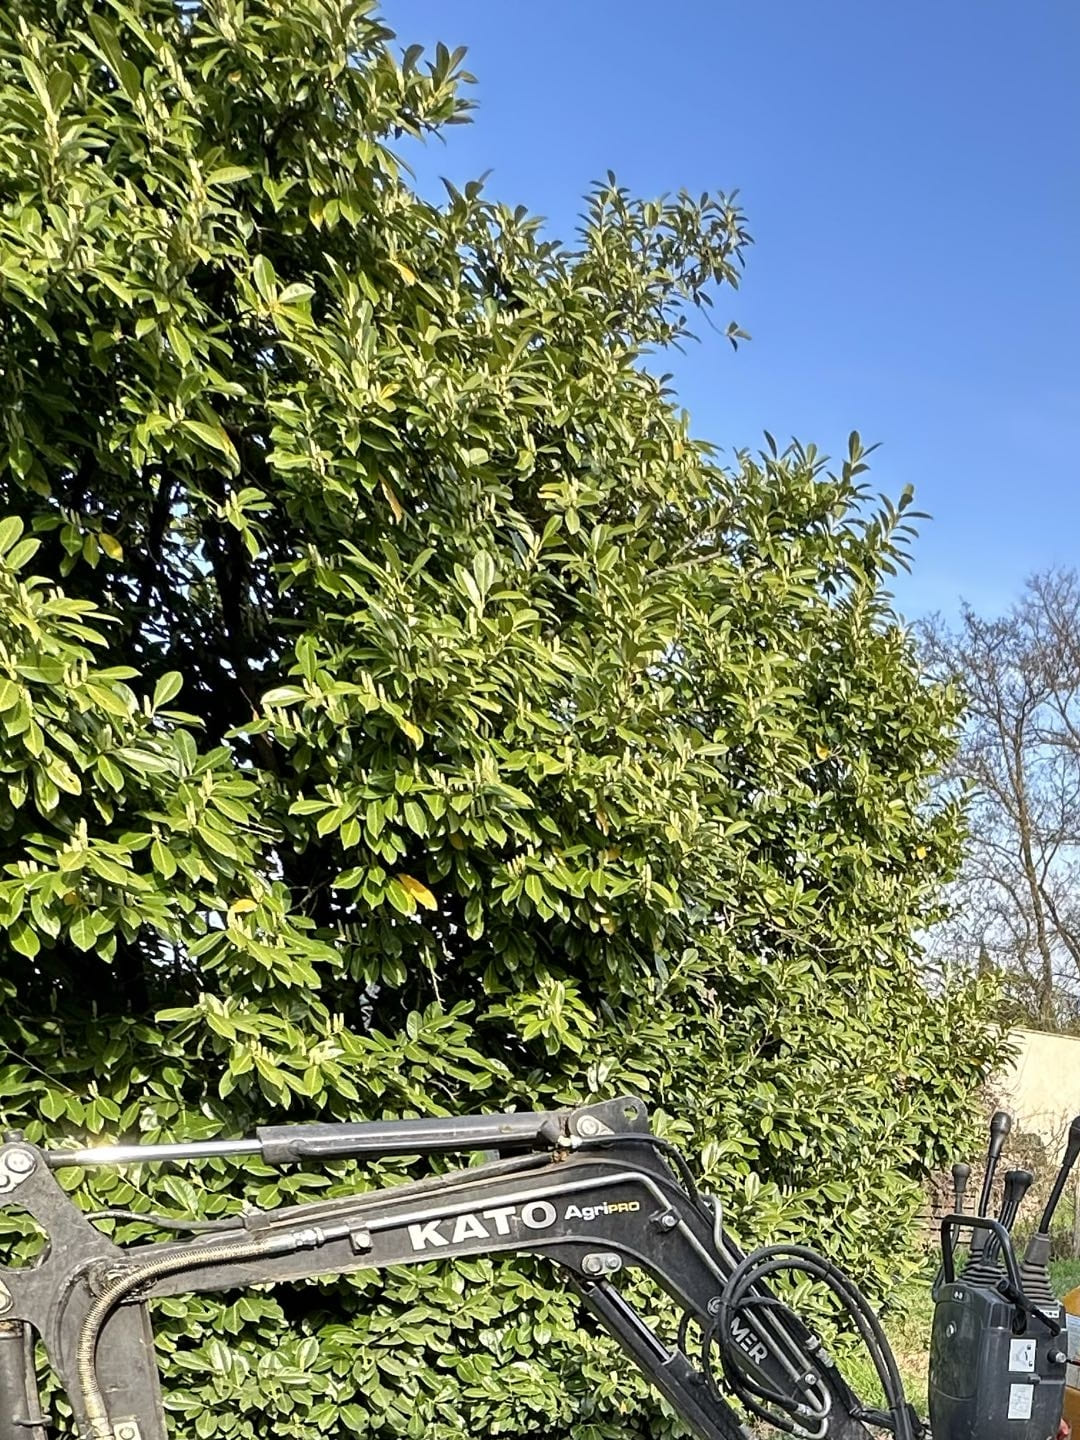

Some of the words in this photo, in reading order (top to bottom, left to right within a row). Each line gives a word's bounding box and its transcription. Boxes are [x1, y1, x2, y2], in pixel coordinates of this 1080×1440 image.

[407, 1201, 557, 1251] KATO
[564, 1201, 641, 1221] AgriPRO
[729, 1316, 769, 1365] MER
